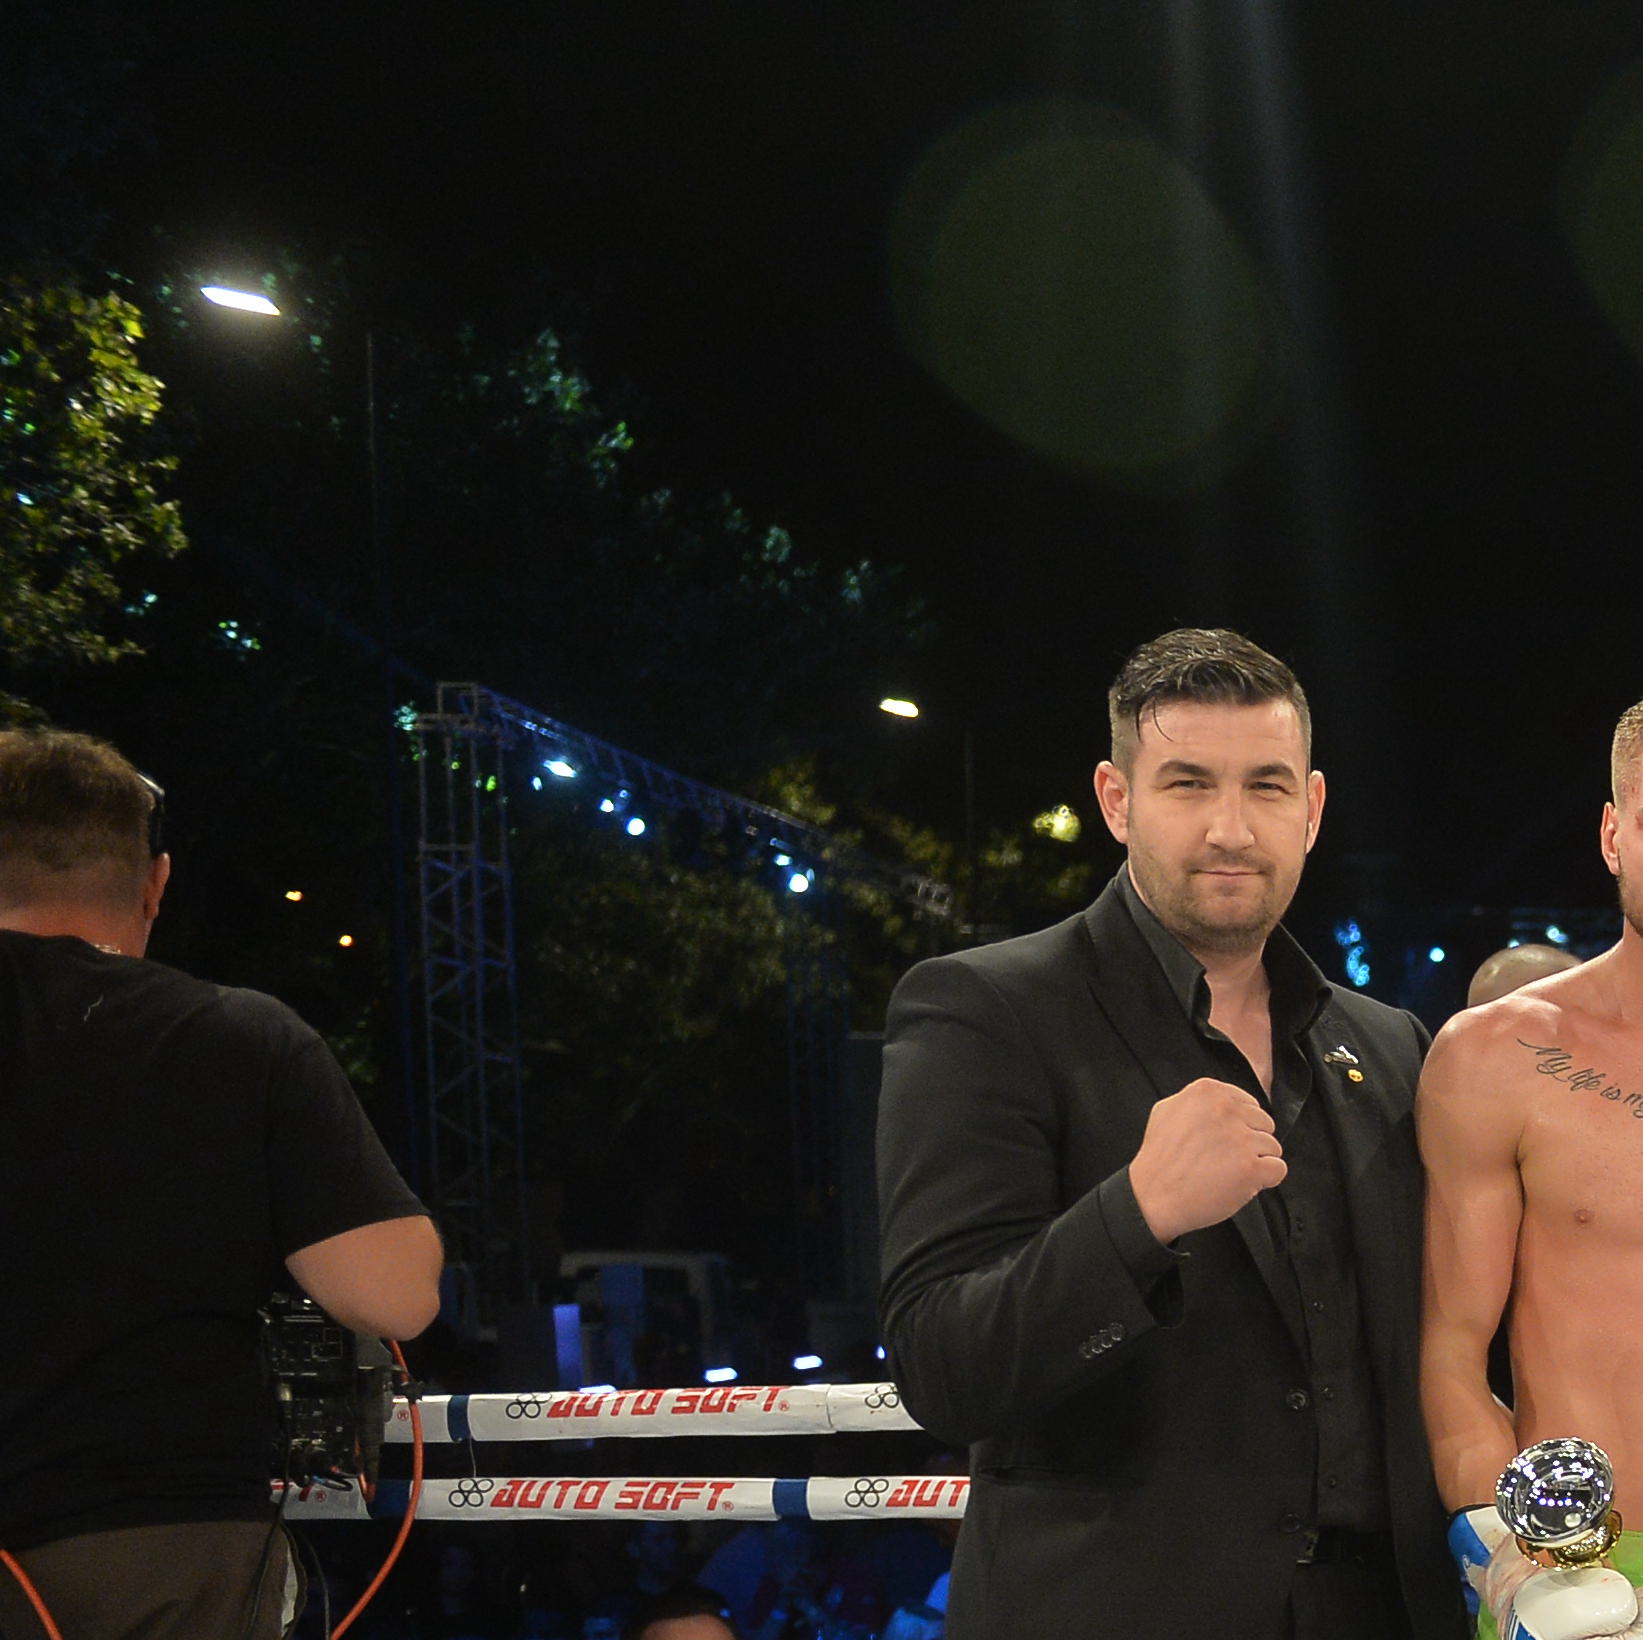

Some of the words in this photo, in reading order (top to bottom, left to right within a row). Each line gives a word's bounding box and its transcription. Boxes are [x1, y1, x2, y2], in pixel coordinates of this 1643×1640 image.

[1568, 1067, 1608, 1092] life
[1600, 1084, 1621, 1101] is
[547, 1388, 666, 1418] AUTO
[672, 1385, 790, 1413] SOFT
[490, 1480, 609, 1511] AUTO
[610, 1481, 735, 1511] SOFT
